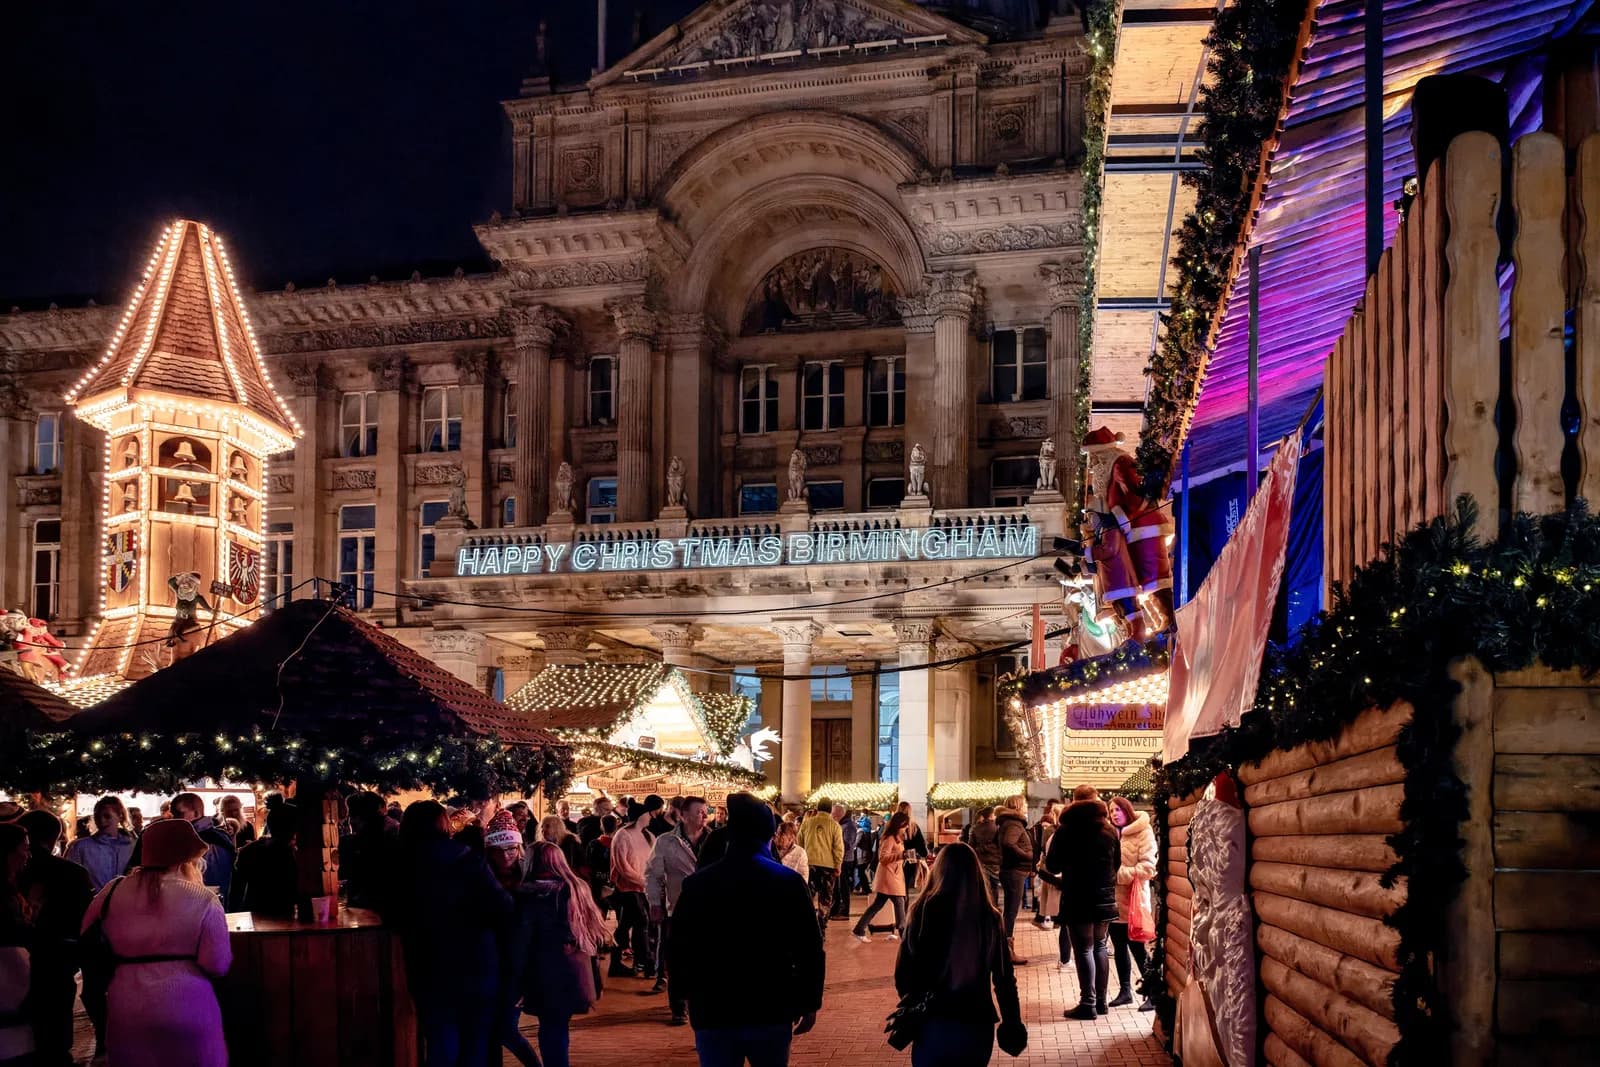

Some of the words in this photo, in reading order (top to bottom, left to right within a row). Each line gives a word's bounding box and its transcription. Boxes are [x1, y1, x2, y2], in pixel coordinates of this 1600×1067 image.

[457, 544, 566, 576] HAPPY
[572, 536, 782, 571] CHRISTMAS
[786, 526, 1036, 564] BIRMINGHAM
